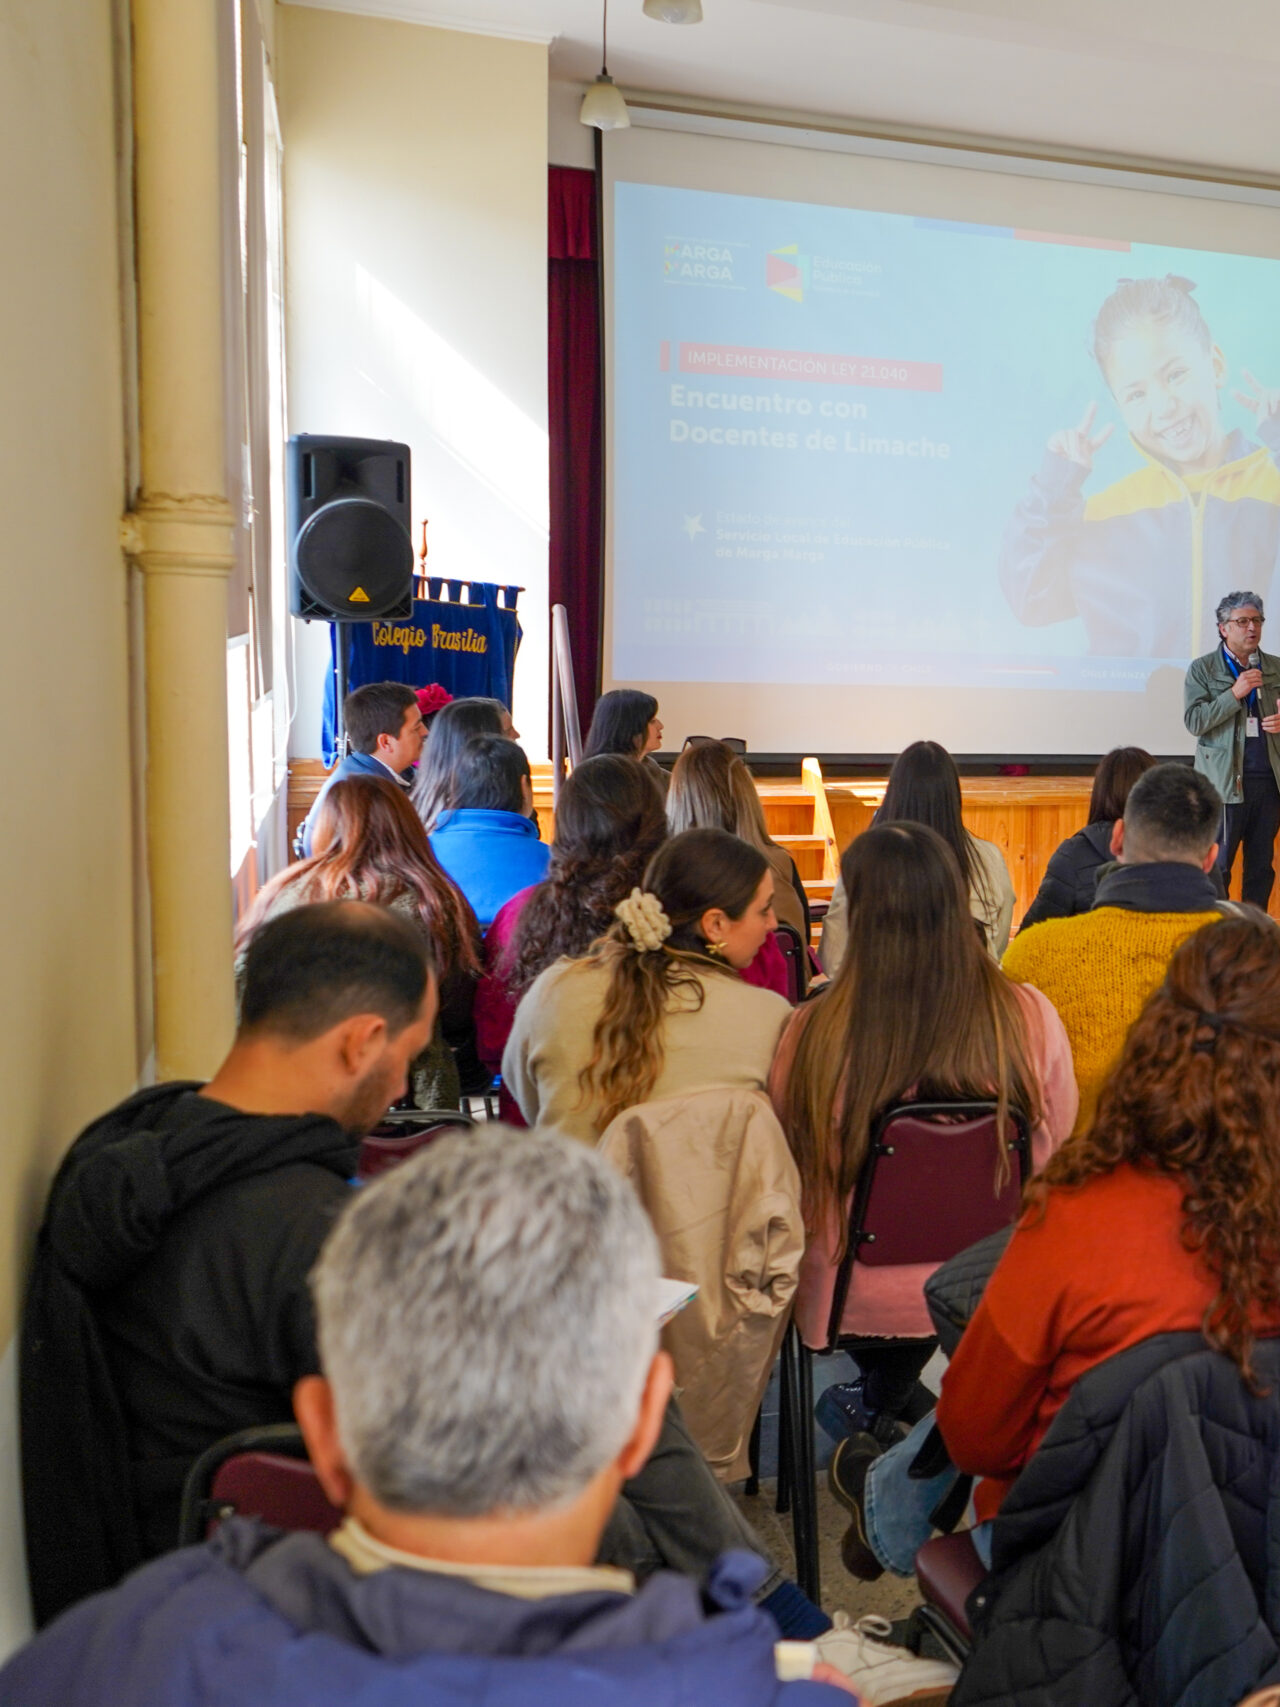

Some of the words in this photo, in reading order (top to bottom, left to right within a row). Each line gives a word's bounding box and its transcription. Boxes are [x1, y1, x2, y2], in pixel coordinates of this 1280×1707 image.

[688, 350, 827, 376] IMPLEMENTACIÓN
[831, 363, 856, 378] LEY
[860, 364, 908, 381] 21.040
[670, 384, 812, 415] Encuentro
[819, 399, 868, 420] con
[669, 419, 798, 449] Docentes
[804, 429, 838, 452] de
[844, 431, 951, 459] Limache
[715, 528, 771, 543] Servicio
[775, 530, 811, 545] Local
[715, 547, 733, 559] de
[736, 546, 779, 561] Marga
[372, 621, 427, 655] Colegio
[432, 623, 488, 654] Brasilia
